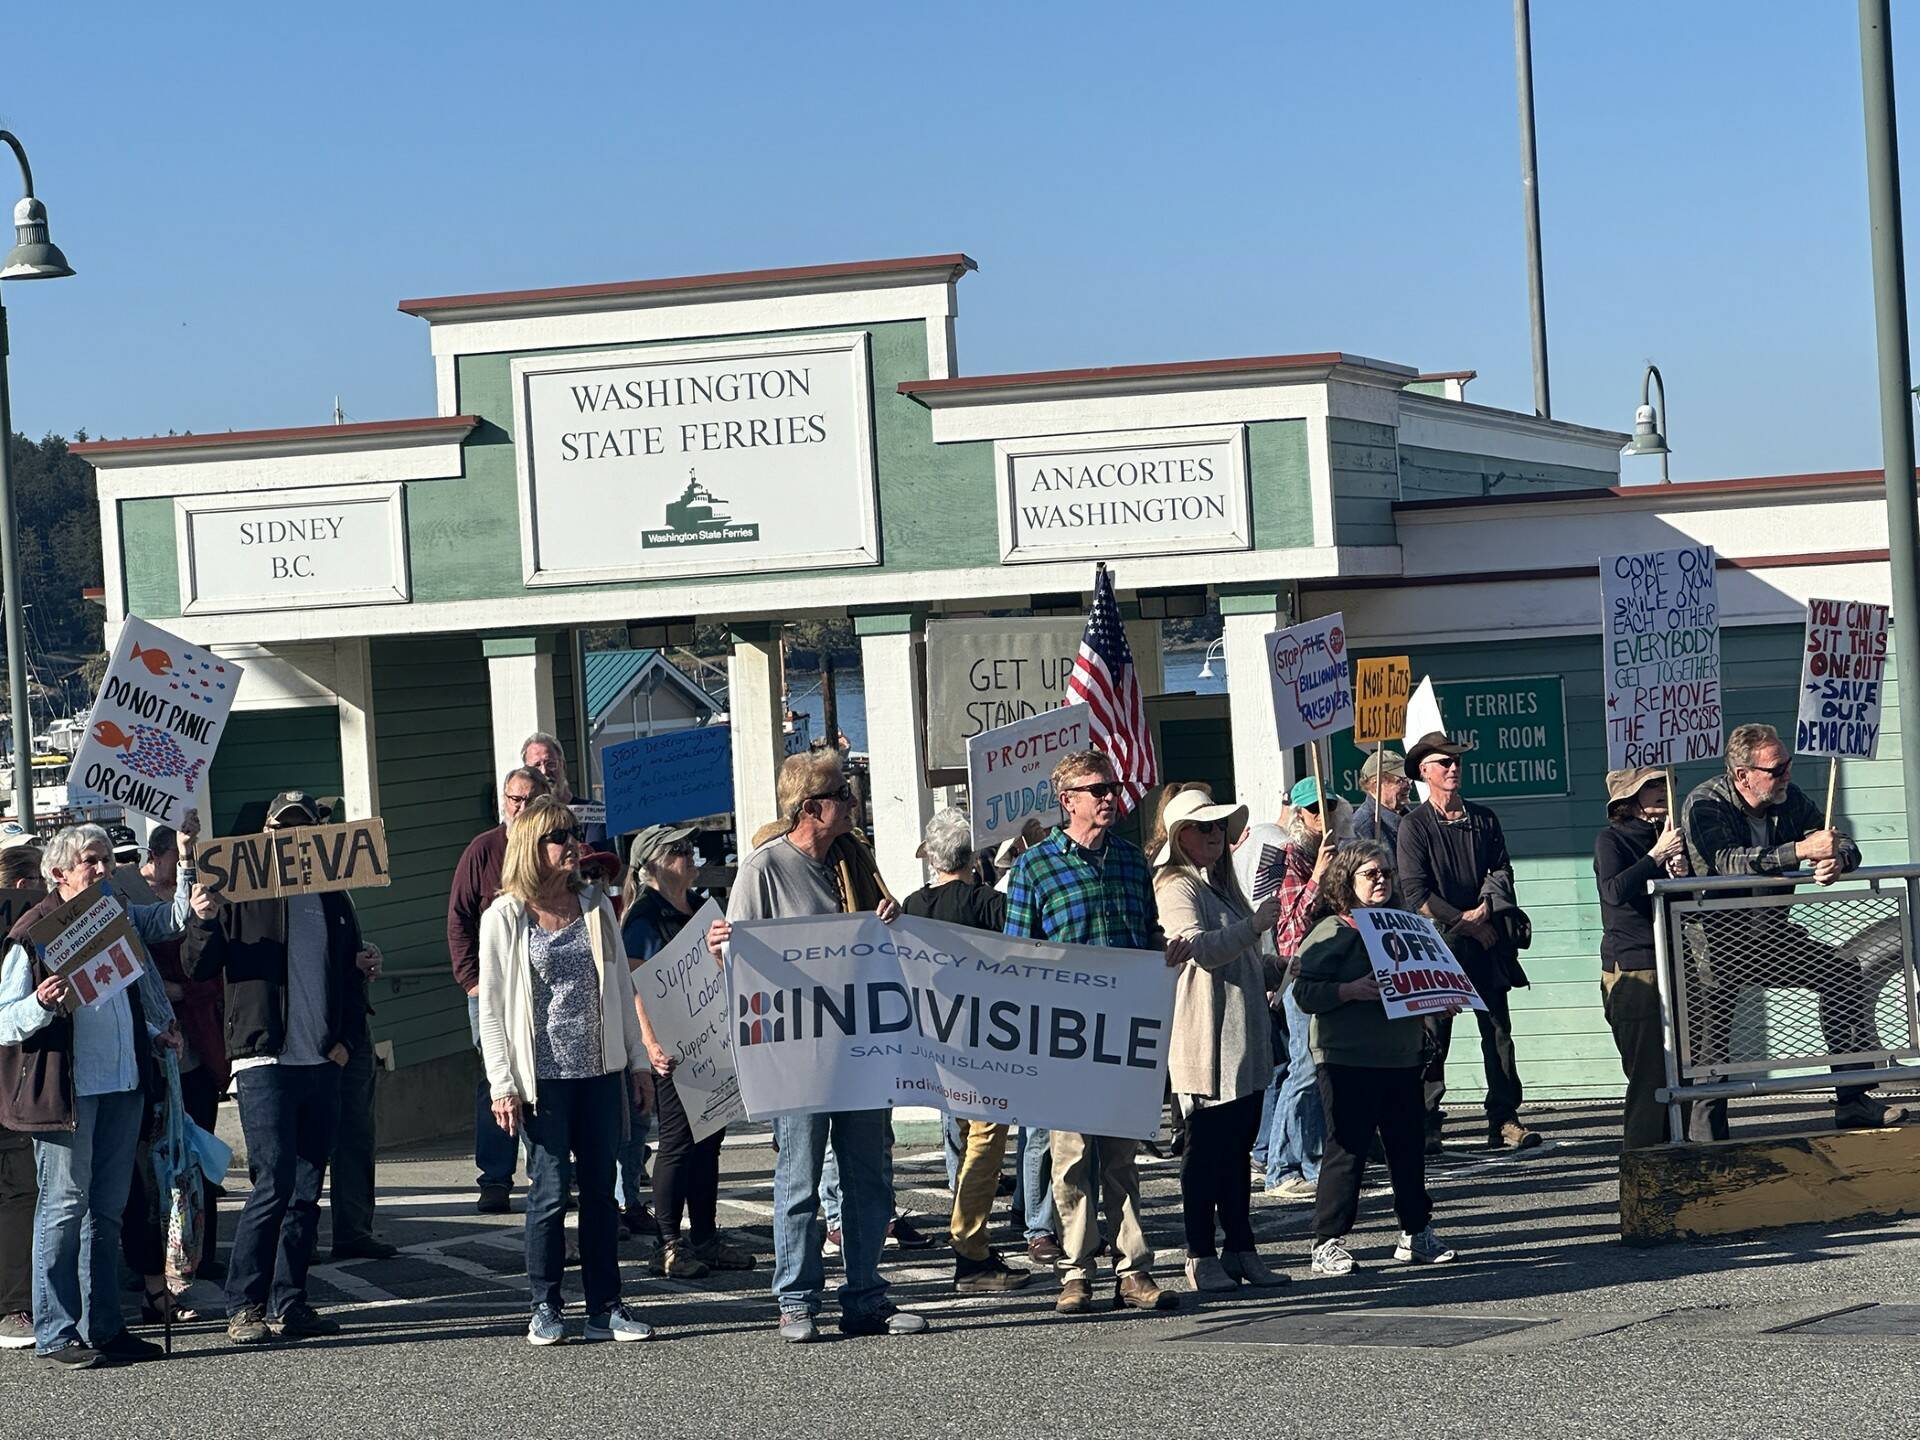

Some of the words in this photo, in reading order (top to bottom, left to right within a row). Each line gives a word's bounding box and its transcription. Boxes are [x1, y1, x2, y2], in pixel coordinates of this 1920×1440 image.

[570, 367, 813, 414] WASHINGTON
[561, 427, 664, 462] STATE
[680, 414, 827, 452] FERRIES
[1031, 457, 1214, 492] ANACORTES
[1021, 494, 1225, 530] WASHINGTON
[240, 516, 345, 545] SIDNEY
[648, 531, 698, 543] Washington
[699, 529, 722, 540] State
[722, 527, 753, 538] Ferries
[272, 554, 315, 579] B.C.
[1615, 552, 1669, 579] COME
[1678, 545, 1710, 573] ON
[1631, 574, 1668, 597] PPL
[1681, 568, 1713, 592] NOW
[1676, 589, 1700, 609] ON
[1613, 613, 1654, 635] EACH
[1668, 602, 1715, 629] OTHER
[1810, 600, 1840, 627] YOU
[1846, 601, 1889, 631] CAN'T
[1276, 649, 1299, 670] STOP
[1303, 632, 1325, 656] THE
[1613, 624, 1719, 667] EVERYBODY
[969, 658, 1028, 692] GET
[1041, 657, 1074, 692] UP
[1614, 665, 1648, 689] GET
[1652, 653, 1719, 685] TOGETHER
[1810, 653, 1850, 679] ONE
[1853, 657, 1886, 680] OUT
[1299, 690, 1351, 722] TAKEOVER
[1465, 692, 1538, 718] FERRIES
[1634, 680, 1718, 714] REMOVE
[1821, 679, 1878, 705] SAVE
[104, 675, 131, 707] DO
[128, 686, 170, 724] NOT
[165, 705, 216, 745] PANIC
[1359, 704, 1382, 739] LESS
[1821, 701, 1868, 722] OUR
[1499, 726, 1546, 749] ROOM
[1610, 714, 1645, 742] THE
[1797, 719, 1879, 758] DEMOCRACY
[986, 723, 1081, 773] PROTECT
[1685, 729, 1720, 761] NOW
[1021, 761, 1040, 774] OUR
[1470, 758, 1558, 785] TICKETING
[84, 763, 180, 822] ORGANIZE
[198, 835, 299, 894] SAVE
[299, 842, 312, 886] THE
[312, 828, 388, 882] V.A.
[45, 939, 64, 957] STOP
[64, 915, 90, 941] TRUMP
[89, 898, 110, 919] NOW!
[53, 949, 71, 967] STOP
[70, 926, 99, 952] PROJECT
[97, 908, 118, 928] 2025!
[1368, 912, 1431, 935] HANDS
[655, 928, 708, 1000] Support
[1381, 931, 1450, 964] OFF!
[783, 941, 967, 969] DEMOCRACY
[976, 958, 1117, 990] MATTERS!
[685, 970, 722, 1018] Labor
[1376, 968, 1396, 997] OUR
[792, 981, 1163, 1070] INDIVISIBLE
[675, 1021, 718, 1066] Support
[691, 1056, 716, 1079] Ferry
[850, 1044, 903, 1058] SAN
[911, 1045, 946, 1065] JUAN
[952, 1055, 1039, 1077] ISLANDS
[895, 1077, 1008, 1110] indivisiblesji.org
